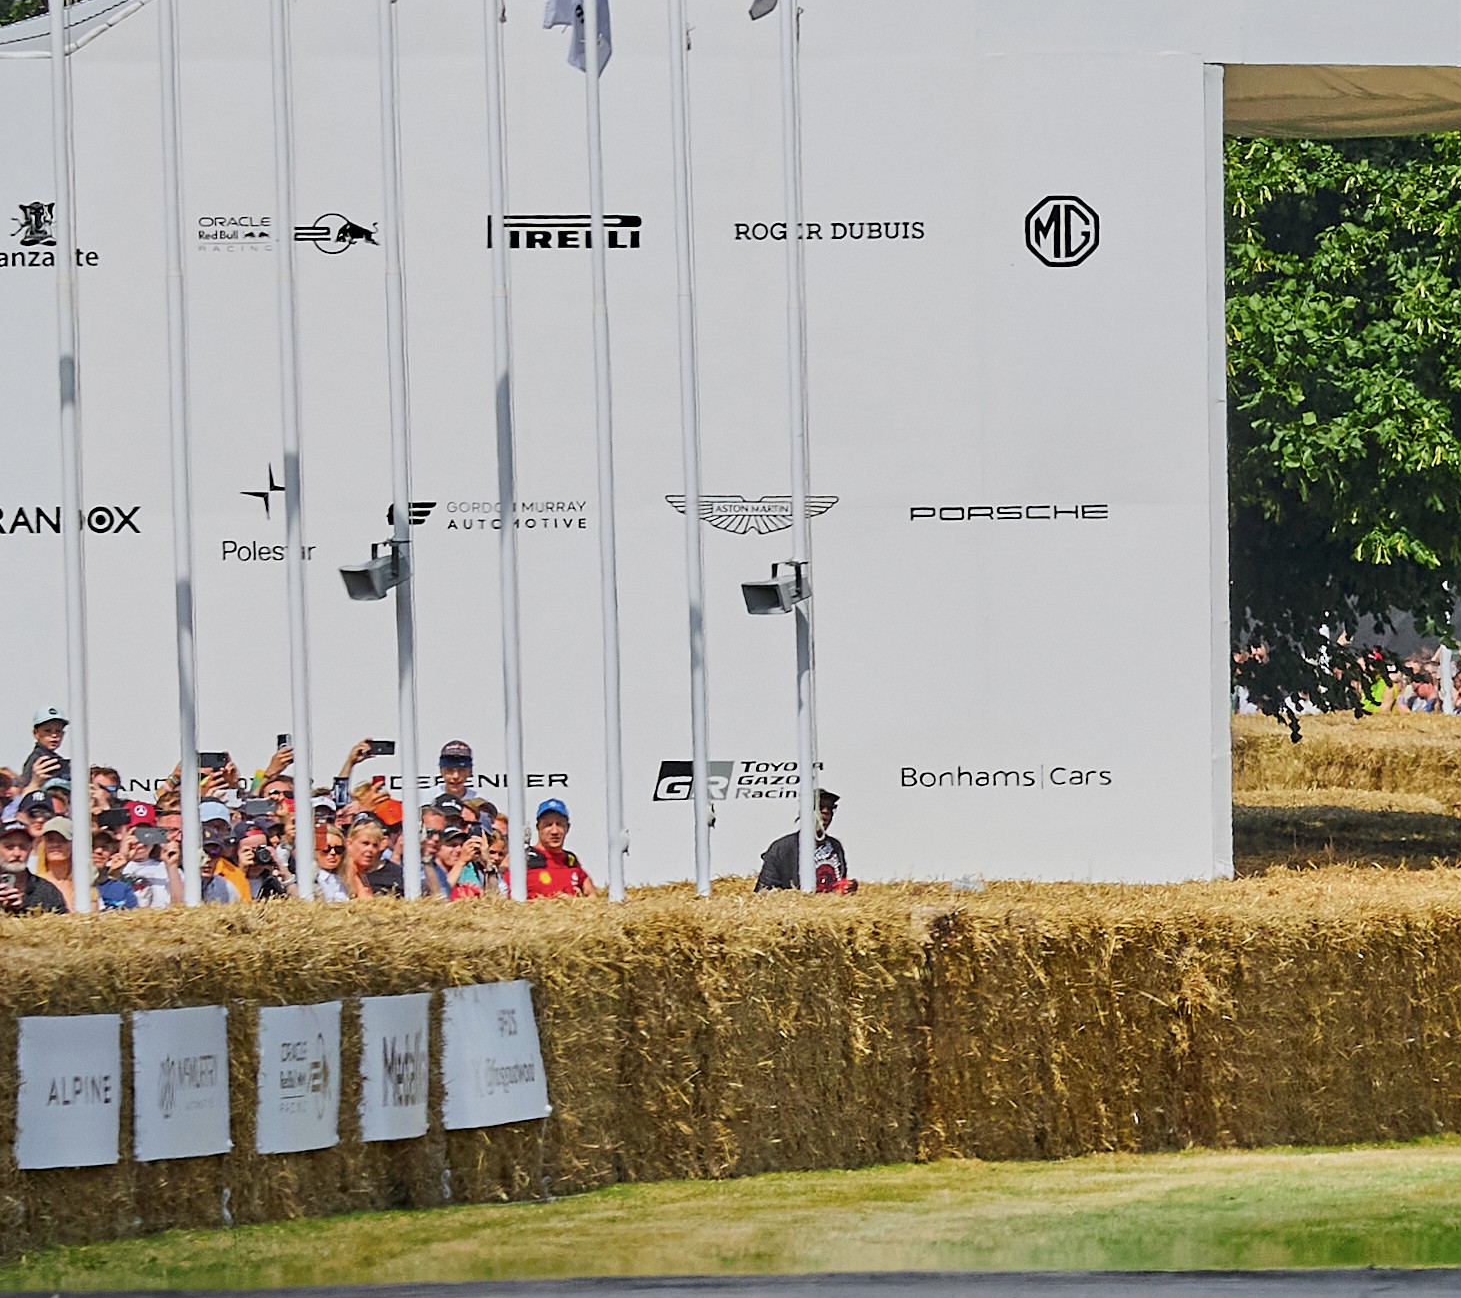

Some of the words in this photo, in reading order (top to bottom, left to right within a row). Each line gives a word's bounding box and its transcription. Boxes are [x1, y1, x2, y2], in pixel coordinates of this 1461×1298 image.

[198, 216, 272, 227] ORACLE
[734, 223, 823, 240] ROGR
[831, 222, 925, 240] DUBUIS
[1033, 204, 1093, 259] MG
[0, 249, 99, 267] anzate
[447, 502, 517, 513] GORD
[522, 502, 587, 512] MURRAY
[715, 504, 749, 513] ASTON
[910, 504, 1109, 521] PORSCHE
[0, 505, 141, 534] ANOX
[222, 540, 316, 562] Polesr
[741, 761, 824, 773] TOYOA
[390, 773, 569, 790] DEFENER
[738, 775, 801, 785] GAZO
[901, 767, 1036, 788] Bonhams
[1050, 767, 1112, 785] Cars
[736, 787, 798, 799] Racin
[47, 1075, 112, 1107] ALPINE
